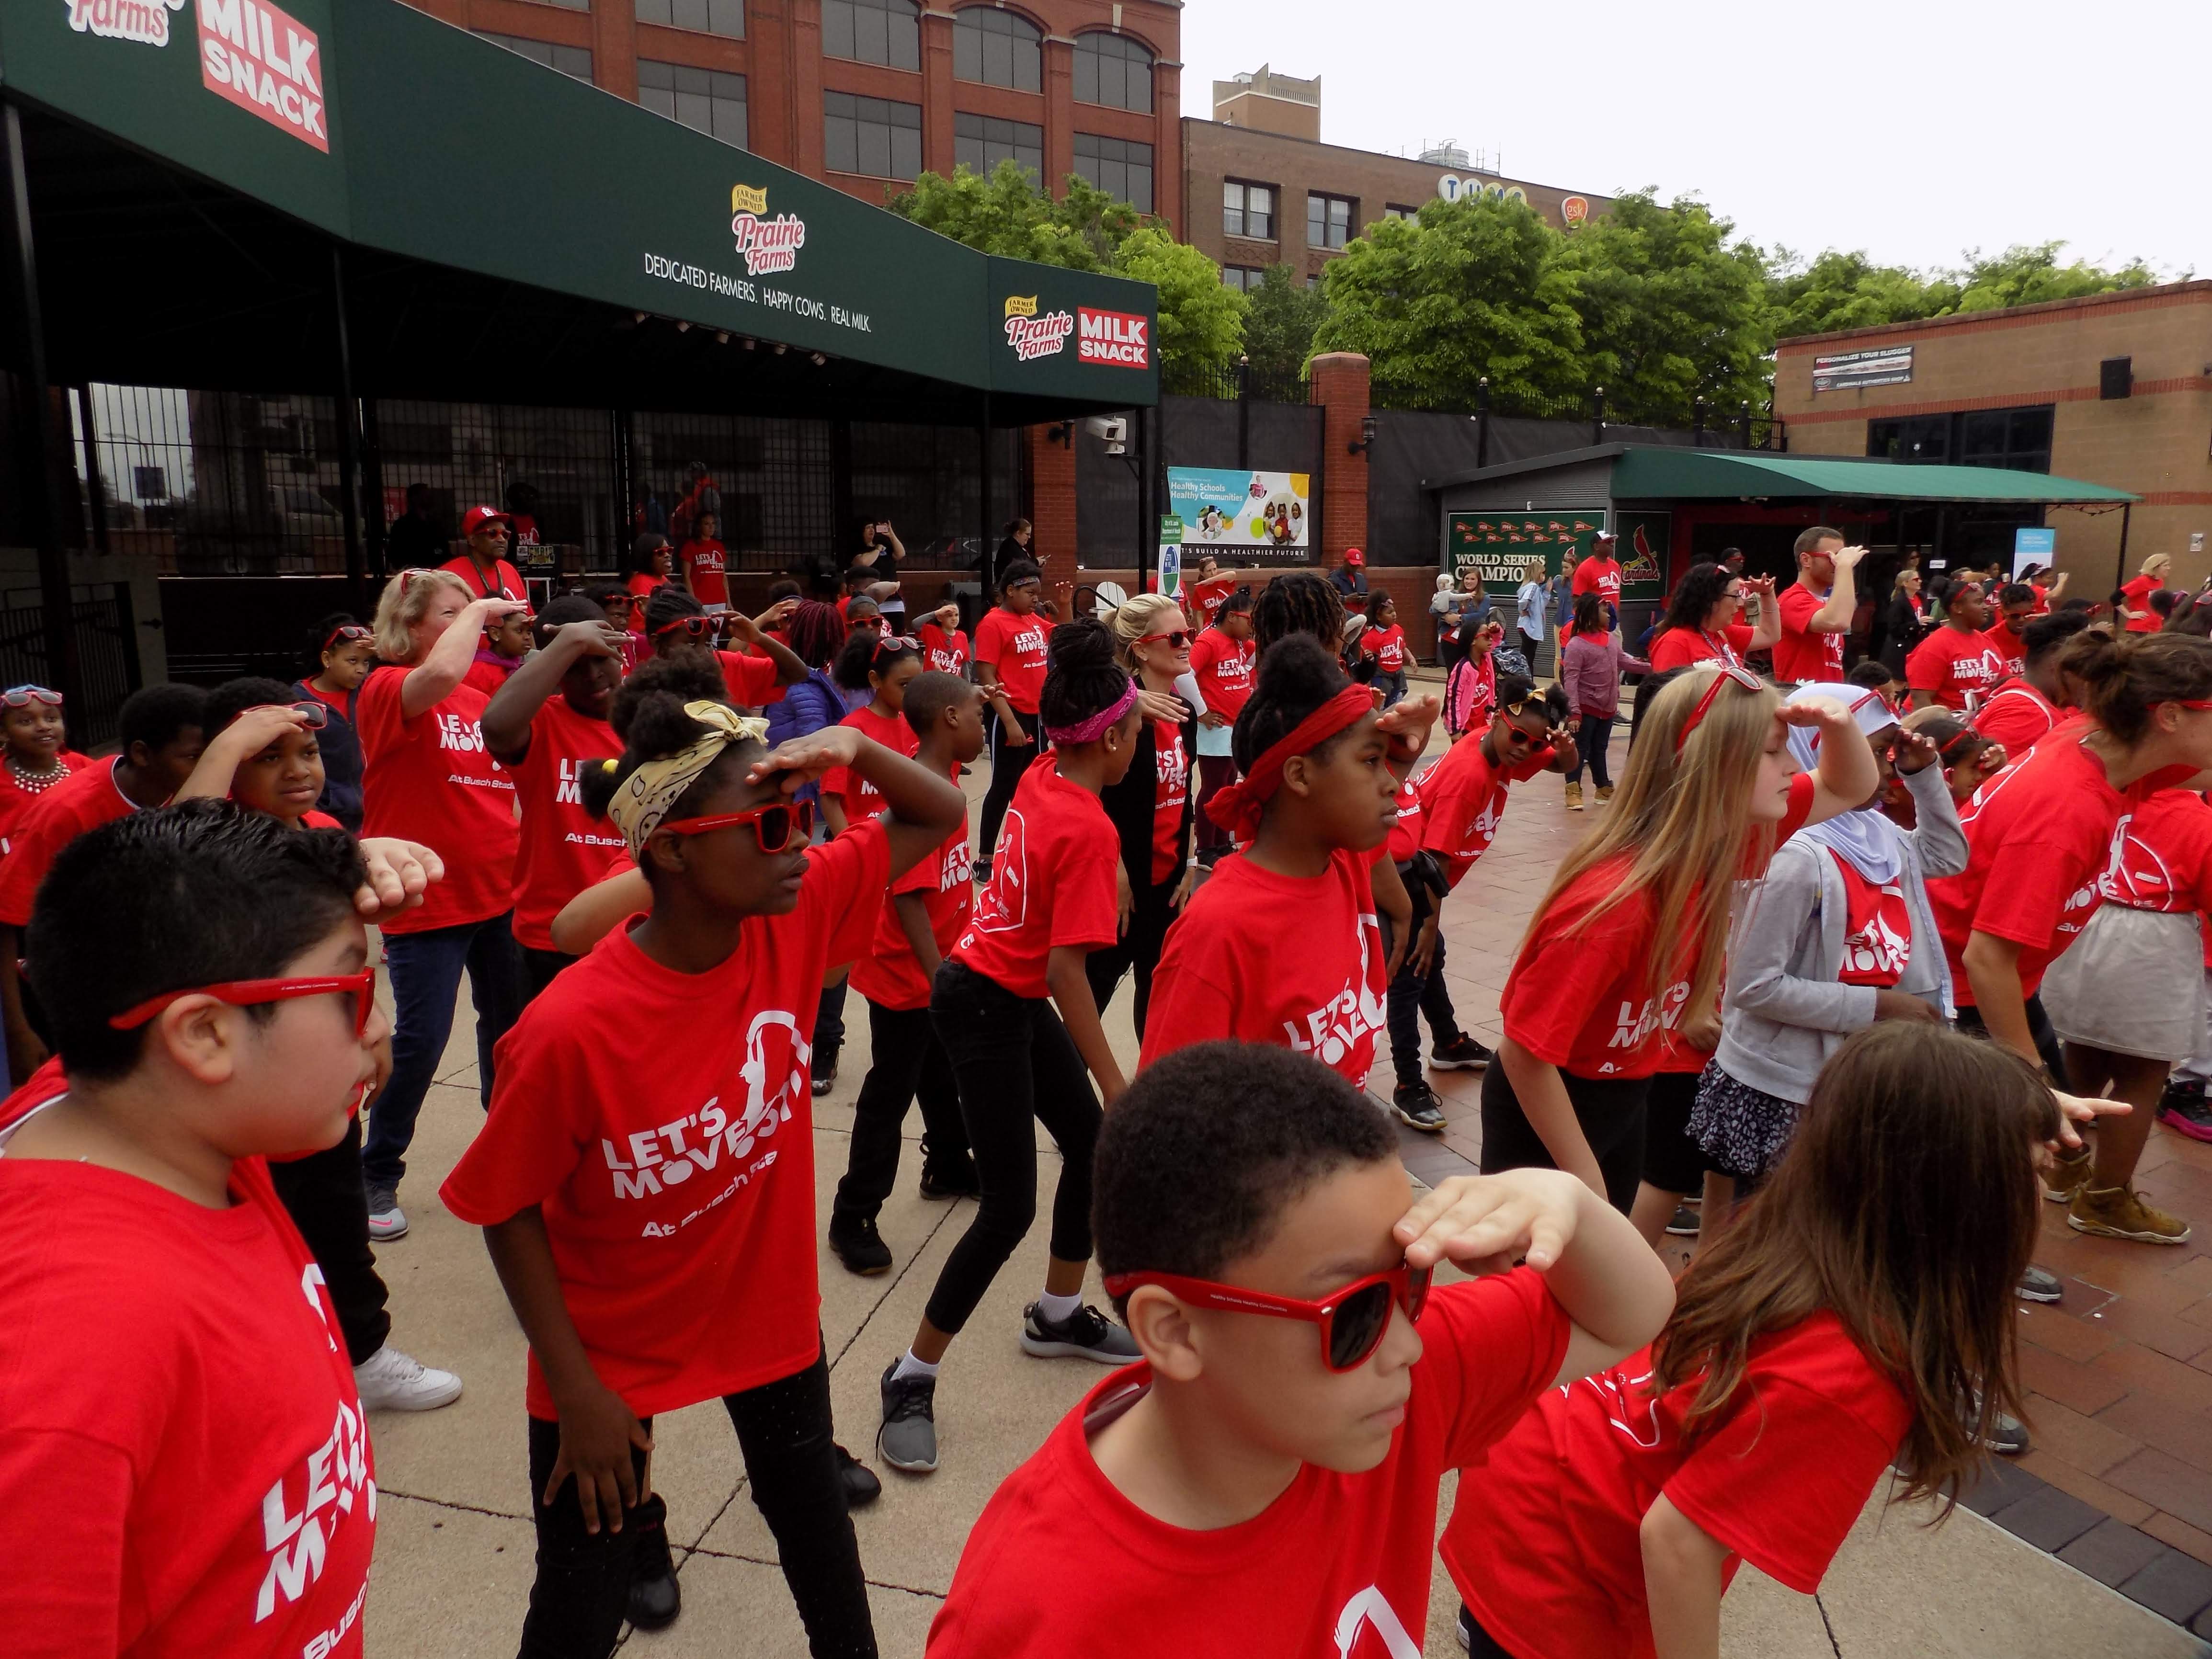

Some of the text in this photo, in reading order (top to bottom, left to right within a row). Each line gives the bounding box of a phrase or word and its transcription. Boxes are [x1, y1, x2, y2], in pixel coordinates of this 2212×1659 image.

[197, 0, 322, 98] MILK
[204, 39, 325, 140] SNACK
[737, 189, 763, 202] FARMER
[738, 198, 762, 212] OWNED
[1567, 203, 1583, 219] gsk
[733, 214, 804, 249] Prairie
[746, 248, 794, 272] Farms
[645, 253, 871, 333] DEDICATED FARMERS. HAPPY COWS. REAL MILK.
[1009, 300, 1034, 308] FARMER
[1010, 306, 1033, 314] OWNED
[1006, 311, 1072, 343] Prairie
[1081, 314, 1146, 345] MILK
[1017, 337, 1062, 358] Farms
[1080, 341, 1146, 364] SNACK
[1171, 482, 1226, 492] Healthy Schools
[1171, 490, 1243, 501] Healthy Communities
[1455, 554, 1546, 566] WORLD SERIES
[1455, 566, 1525, 582] CAMPIO
[1620, 561, 1661, 585] Cardinals
[439, 730, 484, 753] MOV
[448, 774, 463, 784] At
[463, 776, 491, 787] Busch
[1167, 795, 1186, 807] Stad
[565, 832, 582, 844] At
[602, 1096, 727, 1170] LET'S
[641, 1222, 676, 1238] At
